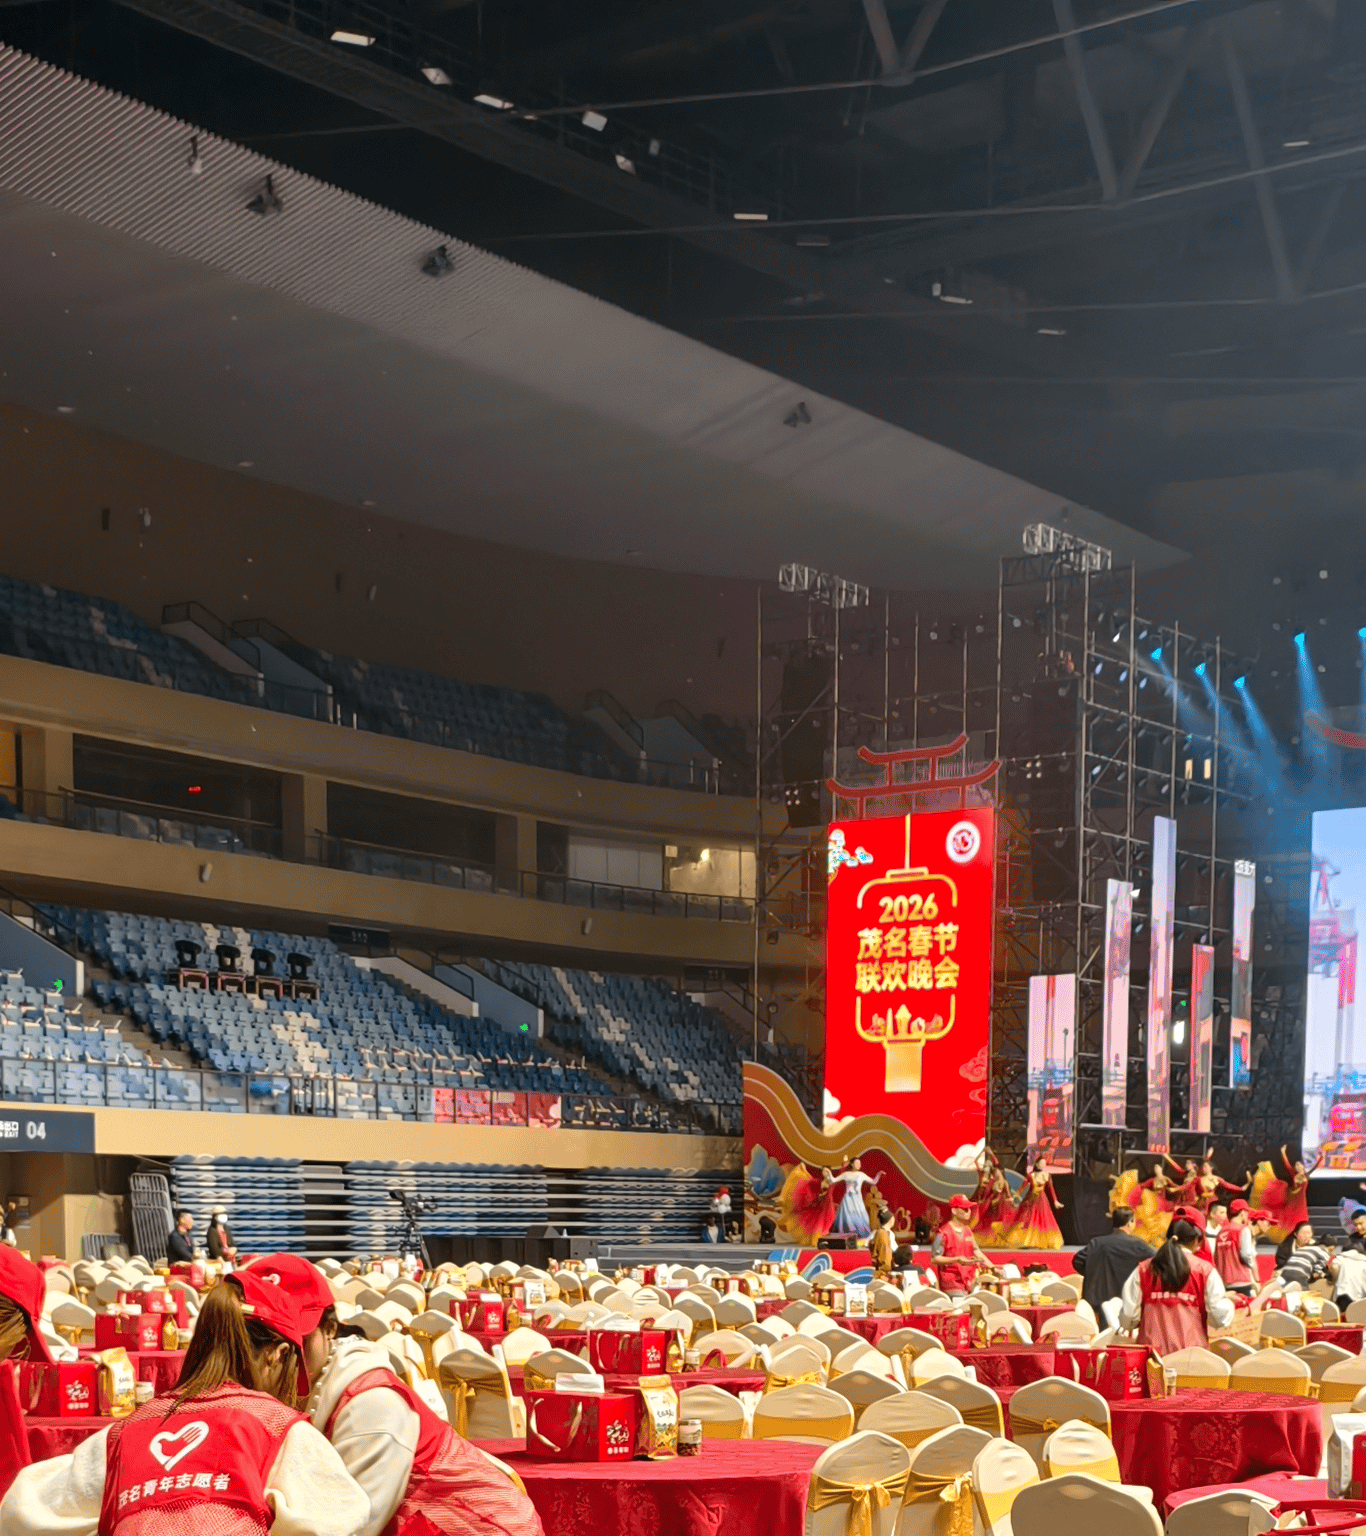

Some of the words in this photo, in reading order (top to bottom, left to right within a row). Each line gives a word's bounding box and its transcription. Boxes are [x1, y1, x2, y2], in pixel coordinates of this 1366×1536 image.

[878, 892, 939, 924] 2026
[857, 921, 960, 961] 茂名春节
[855, 955, 961, 994] 联欢晚会
[26, 1121, 47, 1140] 04
